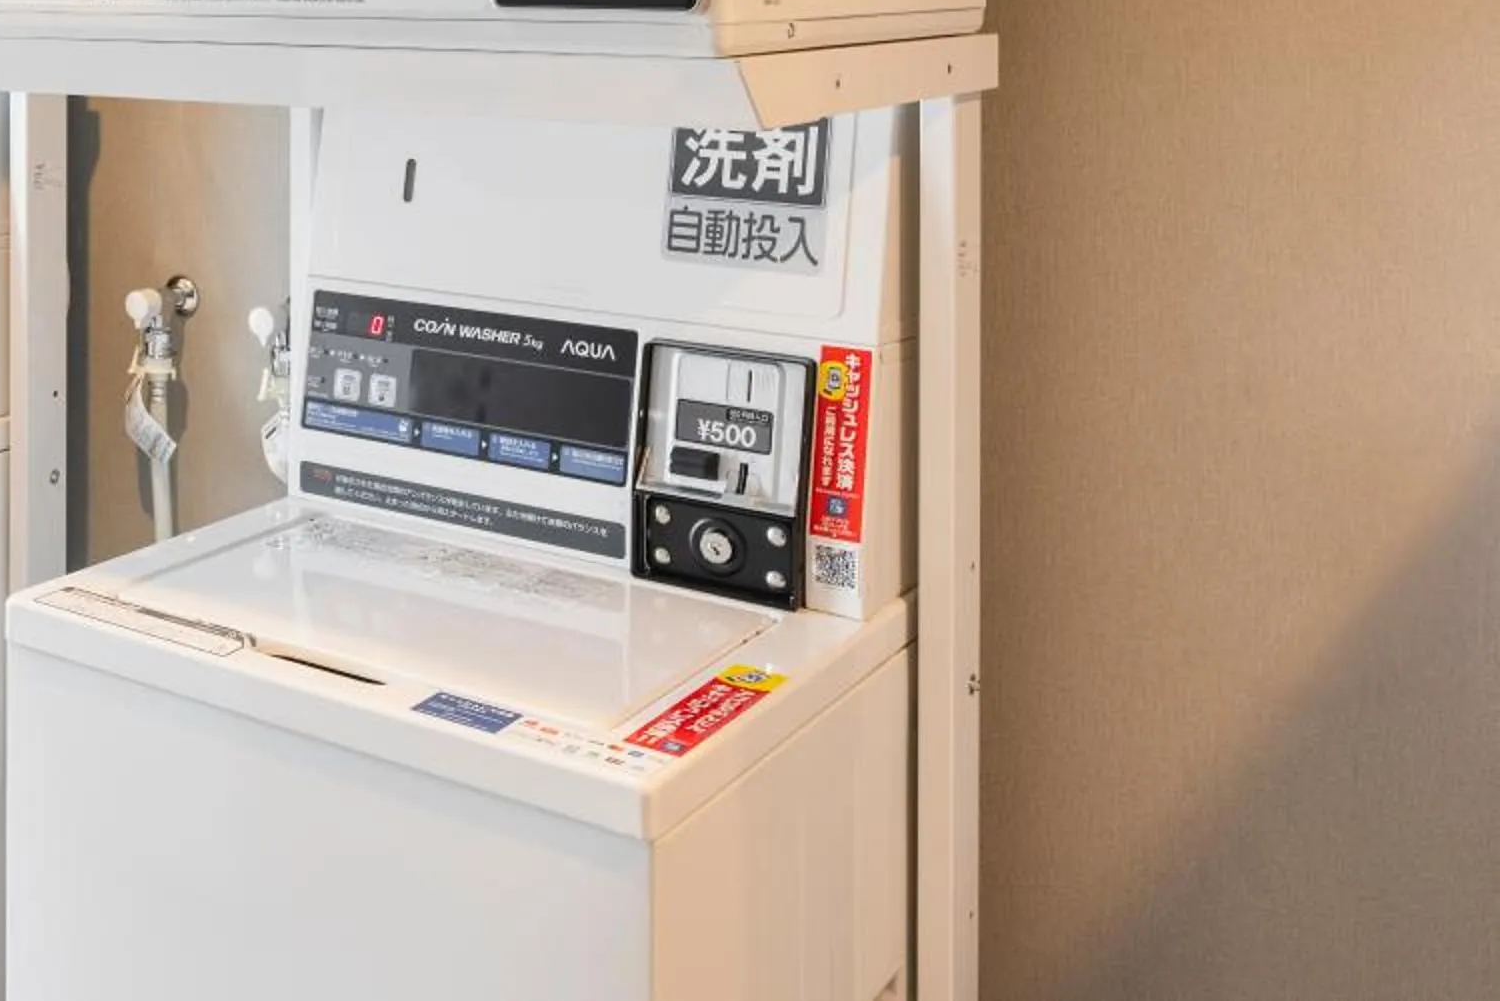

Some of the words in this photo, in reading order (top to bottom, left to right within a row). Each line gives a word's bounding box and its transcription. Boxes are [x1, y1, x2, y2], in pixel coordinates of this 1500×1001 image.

[681, 127, 819, 196] 洗剤
[666, 205, 819, 267] 自動投入
[371, 315, 385, 335] 0
[458, 324, 521, 346] WASHER
[560, 339, 616, 361] AQUA
[697, 418, 757, 448] ¥500
[836, 353, 861, 492] キャッシュレス決済
